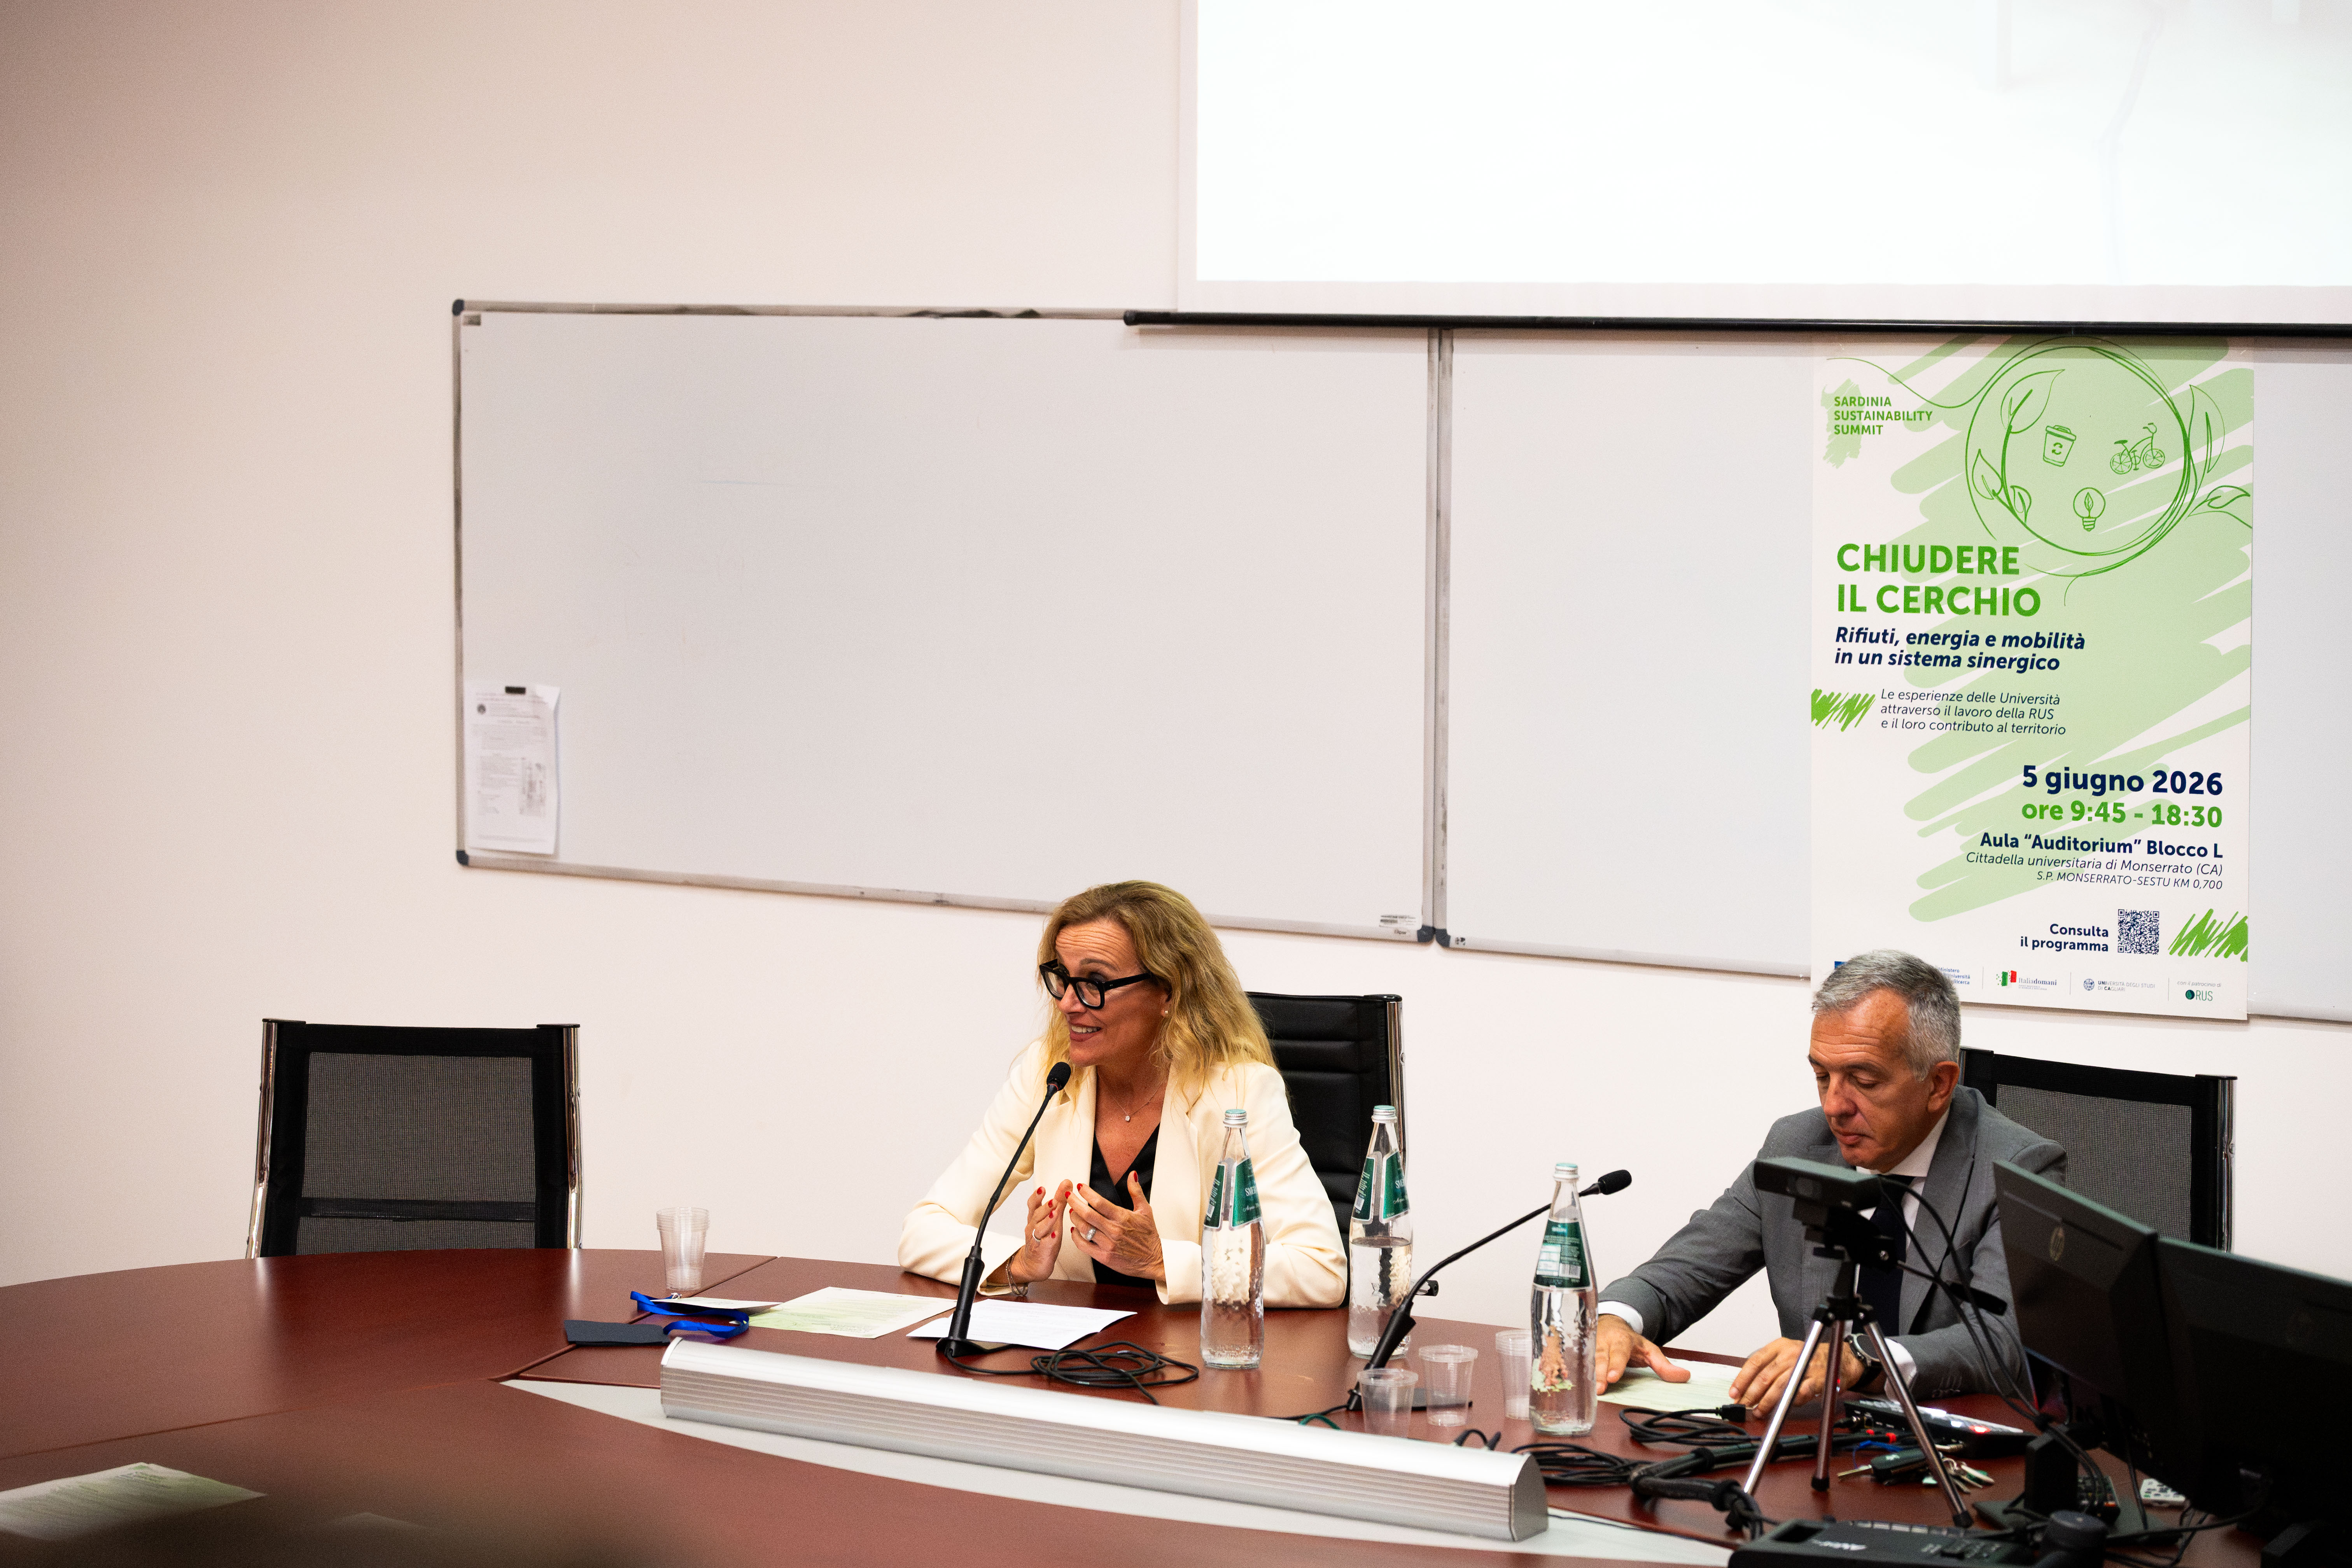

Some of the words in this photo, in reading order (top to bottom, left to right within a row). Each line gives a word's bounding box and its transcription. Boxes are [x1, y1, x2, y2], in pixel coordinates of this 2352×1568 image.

[1834, 396, 1891, 406] SARDINIA
[1834, 410, 1933, 421] SUSTAINABILITY
[1834, 424, 1883, 435] SUMMIT
[1837, 543, 2020, 575] CHIUDERE
[1838, 584, 1867, 612] IL
[1876, 585, 2040, 617] CERCHIO
[1836, 626, 1899, 646] Rifiuti,
[1906, 630, 1980, 651] energia
[1985, 635, 1997, 647] e
[2001, 632, 2085, 649] mobilità
[1835, 648, 1853, 664] in
[1858, 653, 1883, 665] un
[1888, 649, 1962, 668] sistema
[1967, 651, 2060, 674] sinergico
[1881, 689, 1894, 699] Le
[1898, 692, 1963, 702] esperienze
[1966, 691, 1996, 703] delle
[2000, 692, 2060, 705] Università
[1881, 704, 1941, 716] attraverso
[1944, 705, 1951, 716] il
[1954, 705, 1992, 718] lavoro
[1996, 707, 2025, 719] della
[2029, 708, 2054, 720] RUS
[1892, 718, 1898, 728] il
[1902, 719, 1926, 730] loro
[1929, 720, 1994, 732] contributo
[1997, 722, 2008, 733] al
[2011, 723, 2066, 735] territorio
[2023, 765, 2038, 788] 5
[2045, 766, 2144, 797] giugno
[2152, 770, 2223, 796] 2026
[2022, 803, 2063, 820] ore
[2070, 800, 2126, 823] 9:45
[2152, 804, 2222, 828] 18:30
[1980, 832, 2019, 848] Aula
[2147, 840, 2208, 858] Blocco
[2214, 843, 2223, 858] L
[1966, 852, 2024, 865] Cittadella
[2028, 857, 2102, 869] universitaria
[2106, 859, 2117, 870] di
[2121, 860, 2193, 874] Monserrato
[2197, 863, 2222, 877] (CA)
[2037, 871, 2053, 880] S.P.
[2056, 872, 2170, 887] MONSERRATO-SESTU
[2173, 879, 2190, 888] KM
[2193, 880, 2223, 890] 0,700
[2050, 923, 2109, 937] Consulta
[2021, 936, 2028, 947] il
[2032, 940, 2109, 952] programma
[2196, 990, 2213, 1001] RUS
